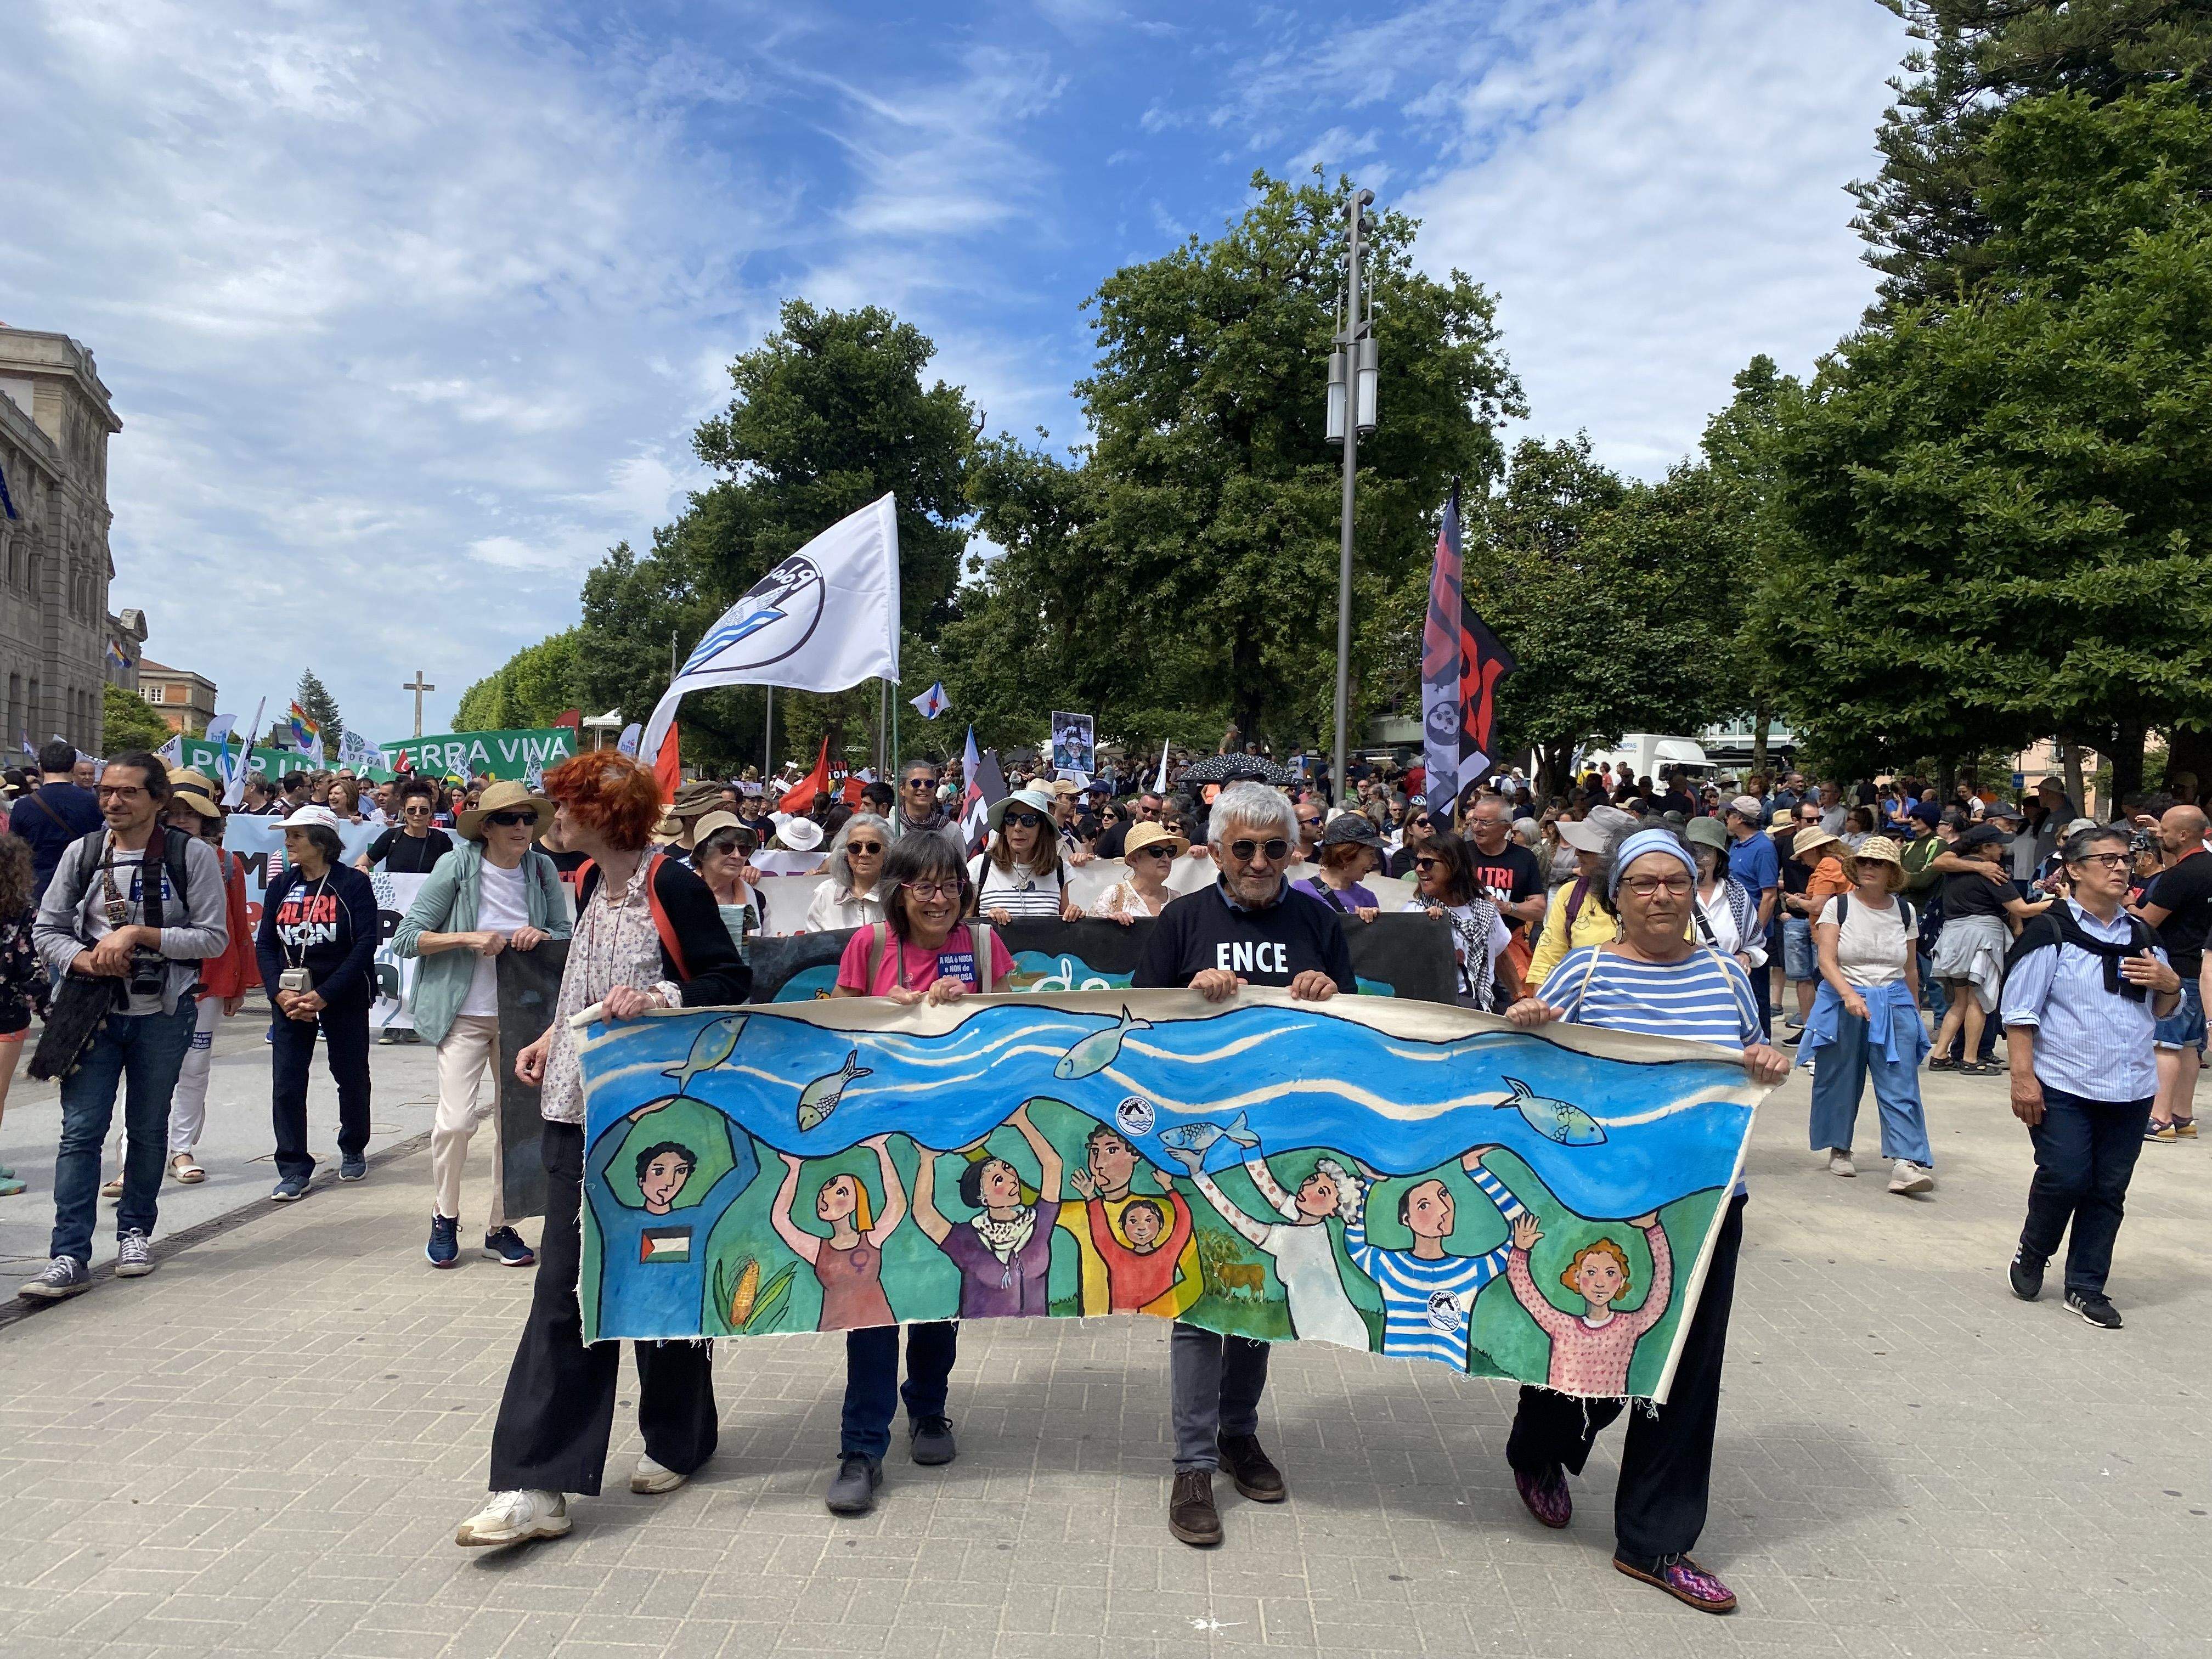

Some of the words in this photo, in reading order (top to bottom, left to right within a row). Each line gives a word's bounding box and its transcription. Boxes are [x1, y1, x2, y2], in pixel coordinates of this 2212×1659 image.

[349, 753, 381, 766] DEGA
[498, 736, 571, 763] VIVA
[1477, 867, 1513, 889] TRI
[276, 895, 336, 924] ALTRI
[950, 964, 961, 973] NON
[1217, 941, 1289, 973] ENCE
